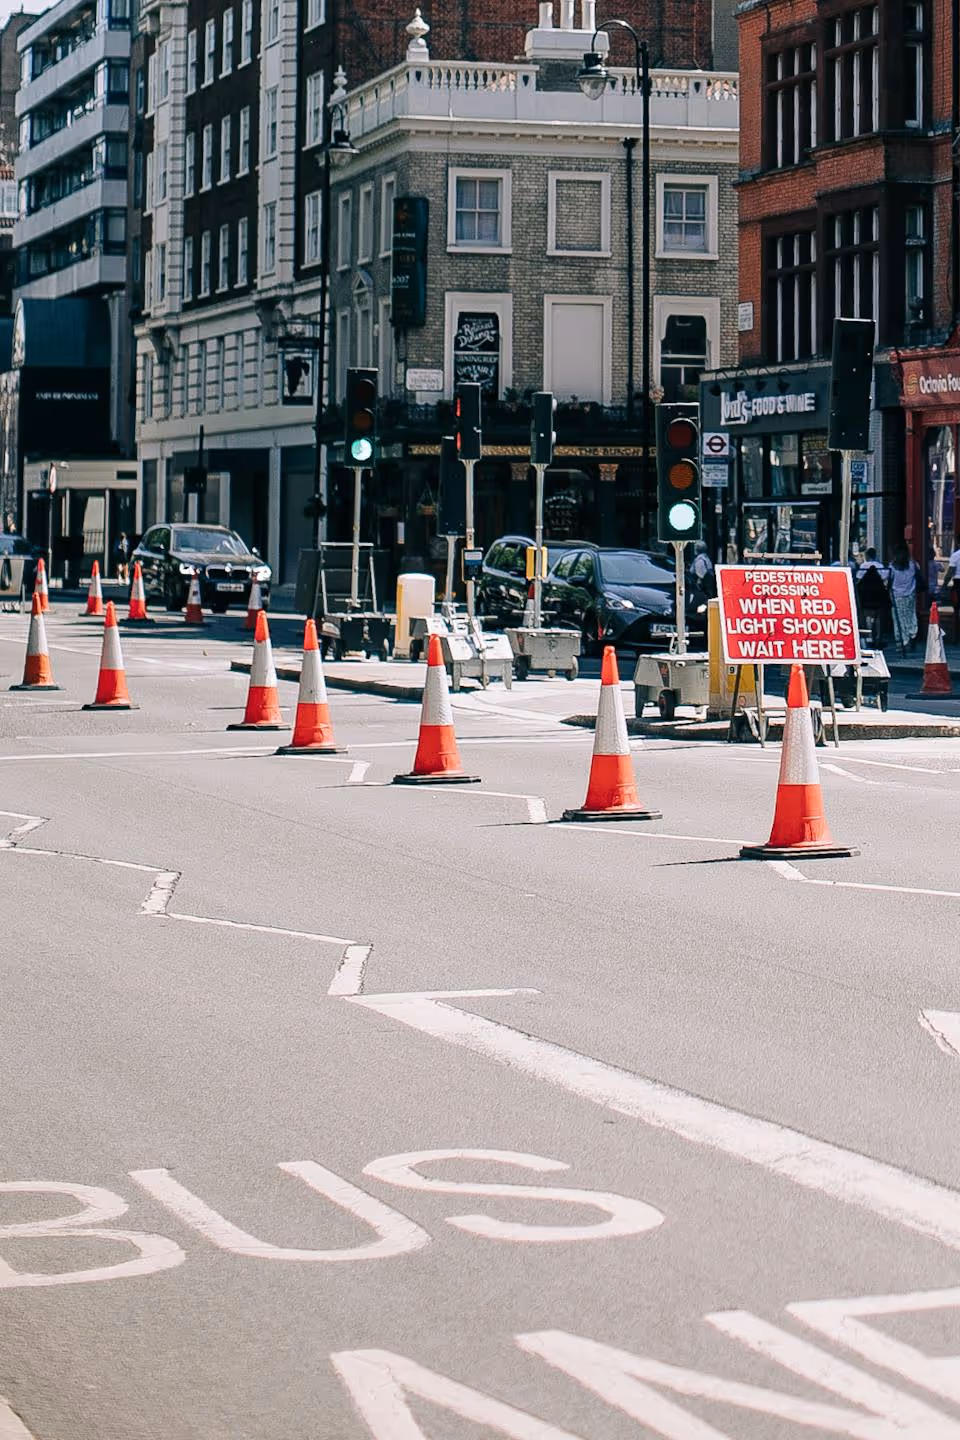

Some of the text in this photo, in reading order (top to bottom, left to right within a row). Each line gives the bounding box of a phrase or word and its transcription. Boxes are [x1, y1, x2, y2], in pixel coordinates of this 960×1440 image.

[919, 374, 948, 394] Octavia
[752, 397, 777, 417] FOOD
[777, 395, 785, 415] &
[785, 392, 816, 413] WINE
[745, 571, 824, 584] PEDESTRIAN
[752, 584, 820, 597] CROSSING
[738, 598, 836, 616] WHEN RED
[726, 618, 852, 636] LIGHT SHOWS
[738, 639, 846, 659] WAIT HERE
[0, 1147, 666, 1288] BUS
